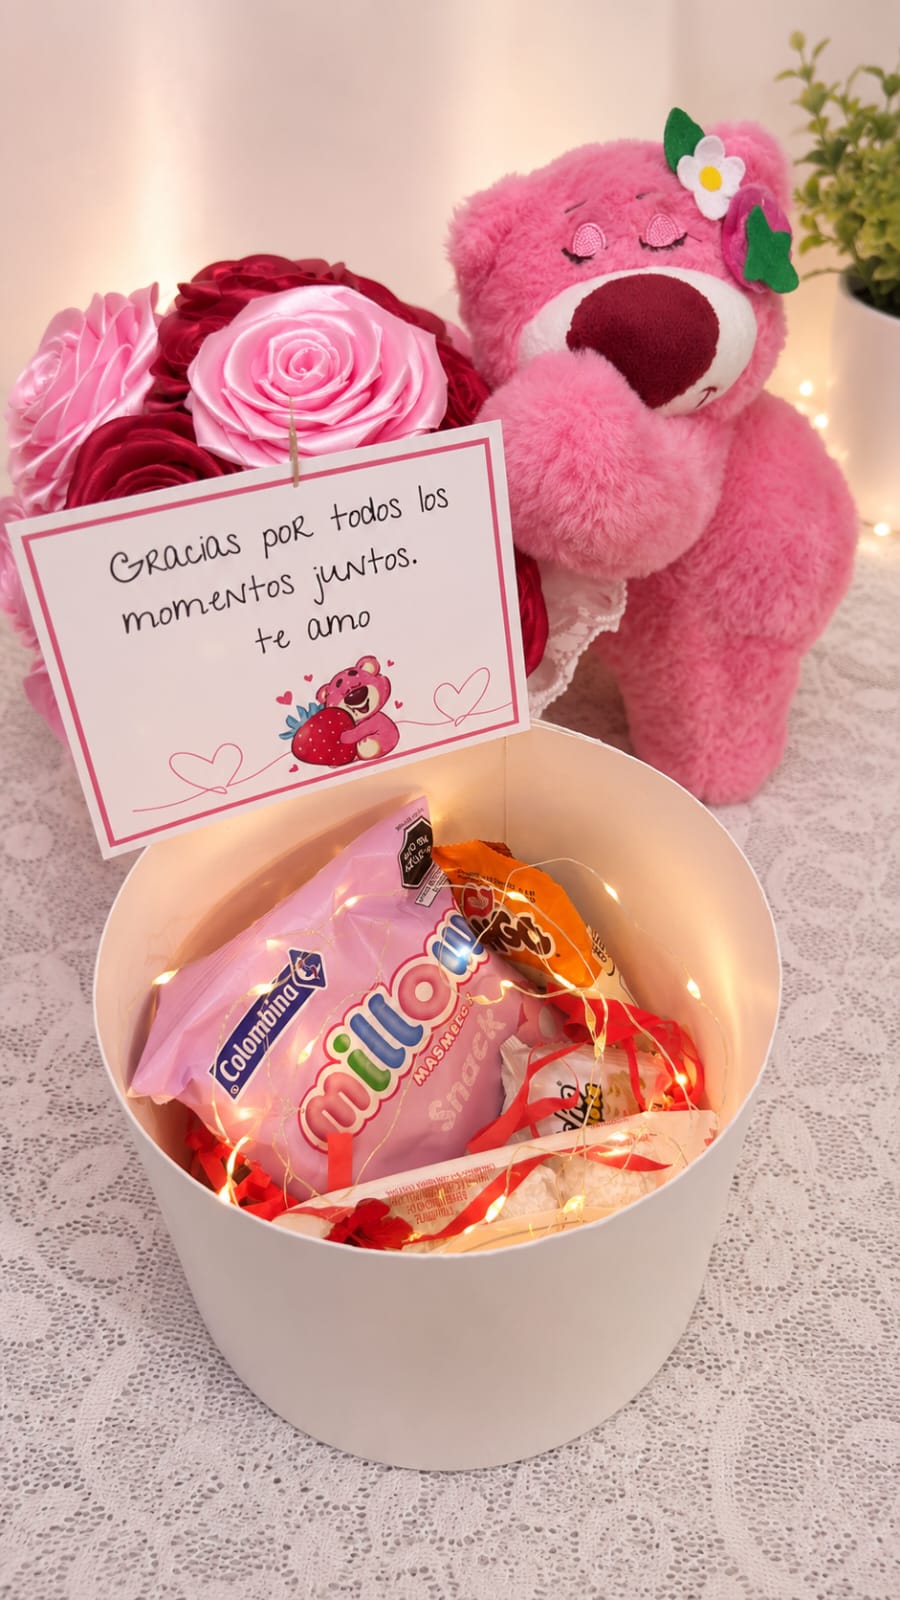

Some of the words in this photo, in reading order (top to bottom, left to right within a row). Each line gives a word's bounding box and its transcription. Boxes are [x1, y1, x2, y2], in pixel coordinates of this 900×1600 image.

[330, 497, 402, 531] todos
[417, 485, 449, 513] los
[255, 628, 291, 654] te
[307, 610, 371, 641] amo
[218, 982, 300, 1083] Colombina
[427, 1008, 507, 1132] Snack
